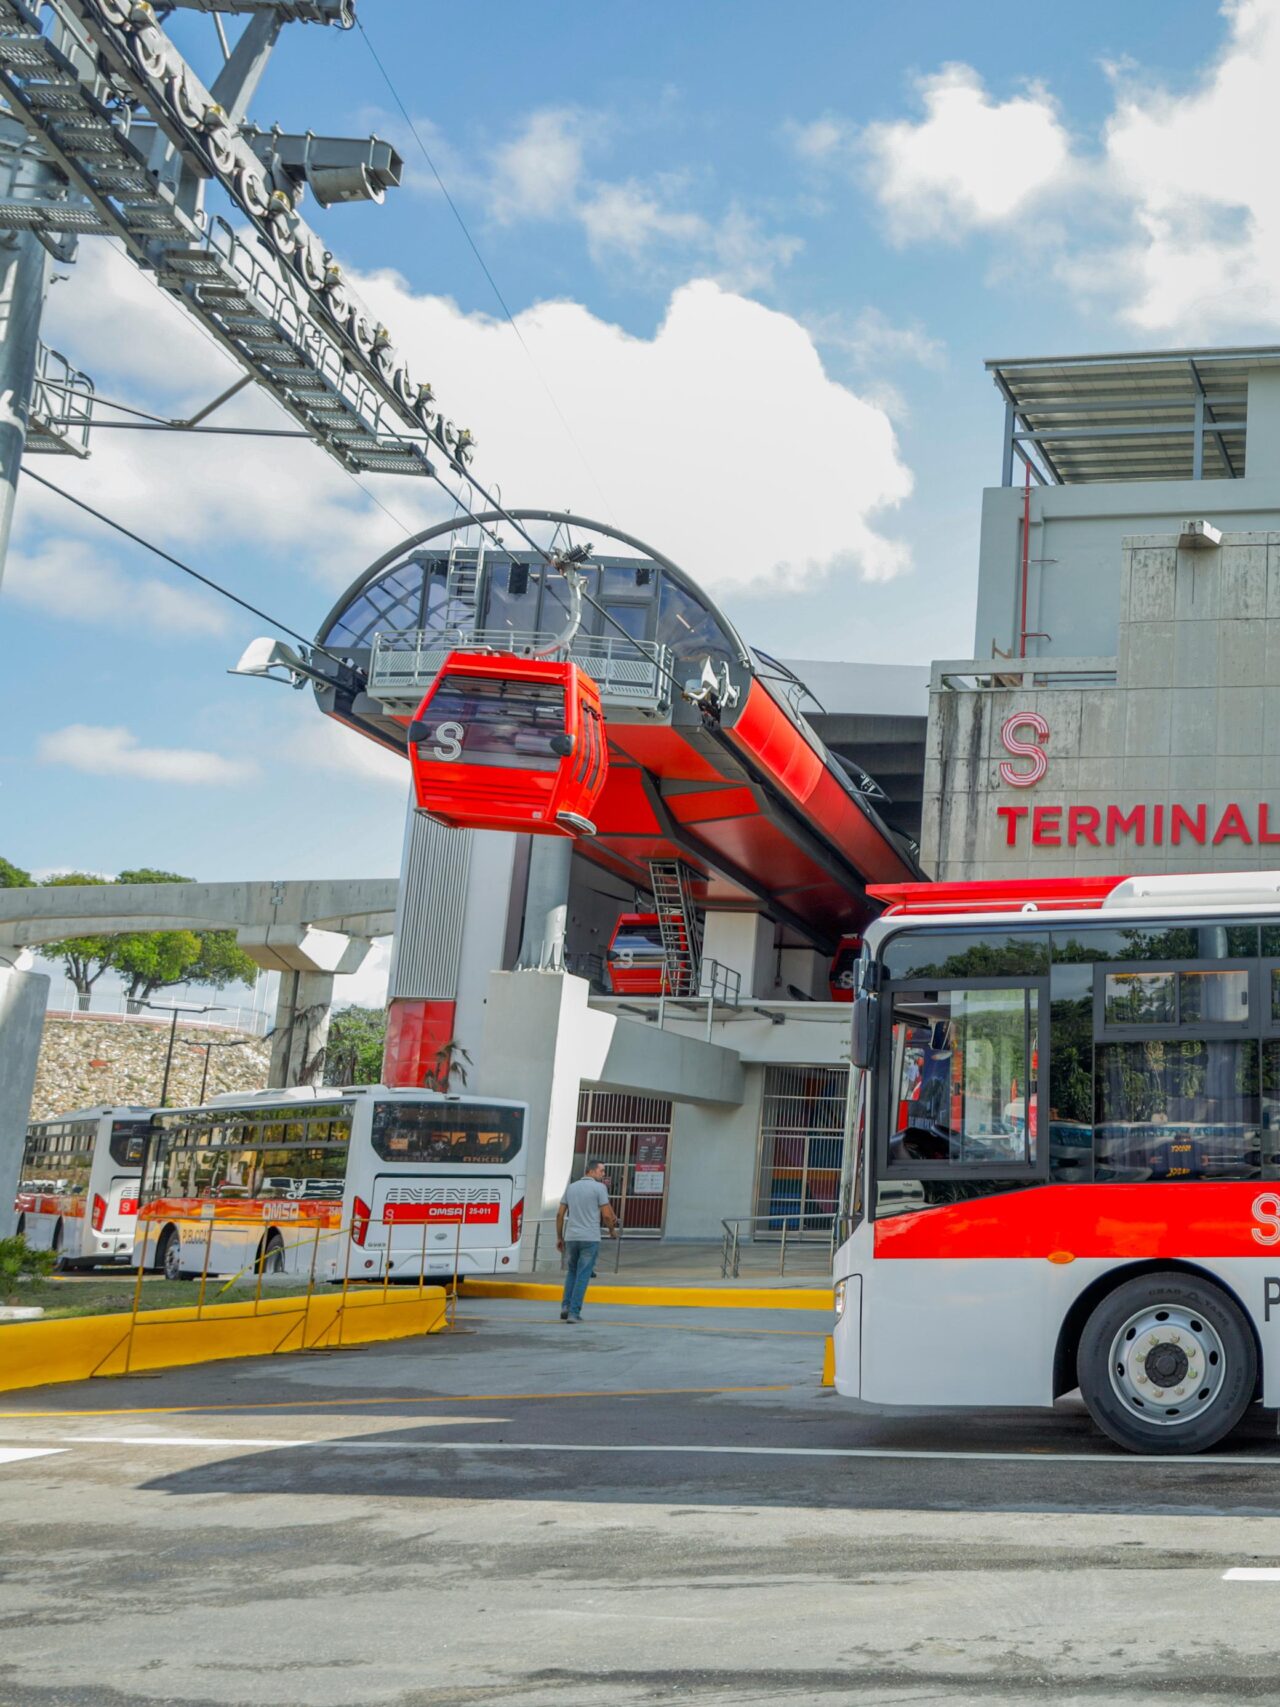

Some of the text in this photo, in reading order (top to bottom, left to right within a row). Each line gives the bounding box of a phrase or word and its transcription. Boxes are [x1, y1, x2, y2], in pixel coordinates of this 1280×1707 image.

[433, 721, 464, 762] S
[1000, 711, 1049, 789] S
[428, 1207, 462, 1216] OMSA
[469, 1207, 491, 1215] 25-011
